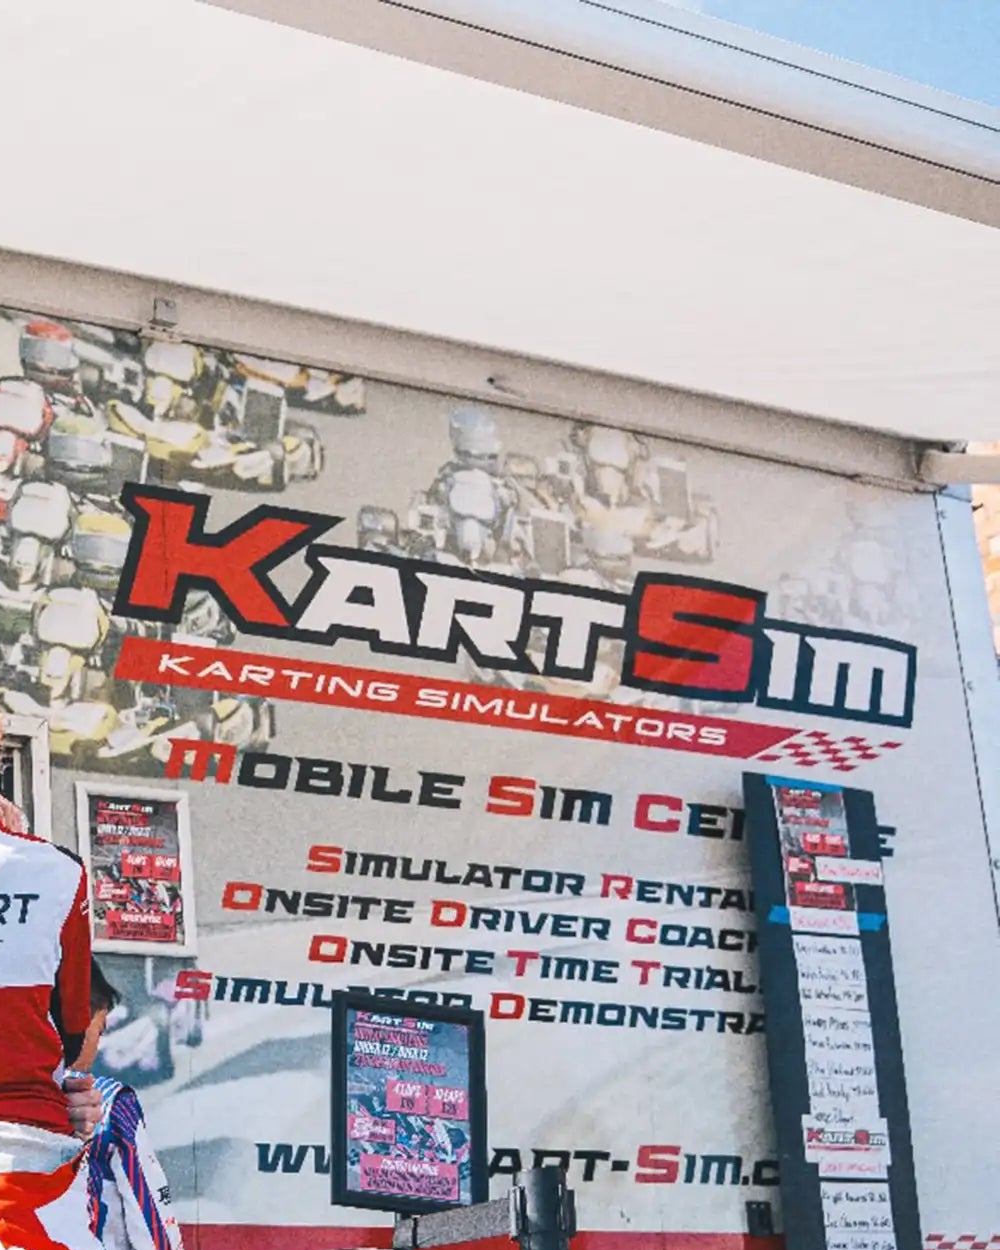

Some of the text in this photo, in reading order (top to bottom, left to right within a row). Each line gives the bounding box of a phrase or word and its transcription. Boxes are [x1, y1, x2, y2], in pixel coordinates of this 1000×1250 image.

[112, 483, 918, 728] KARTSIM
[157, 652, 728, 747] KARTING SIMULATORS
[164, 737, 465, 809] MOBILE
[487, 775, 612, 826] SIM
[306, 844, 586, 896] SIMULATOR
[221, 882, 415, 924] ONSITE
[431, 900, 611, 942] DRIVER
[308, 934, 494, 974] ONSITE
[506, 949, 619, 984] TIME
[631, 959, 764, 994] TRIAL
